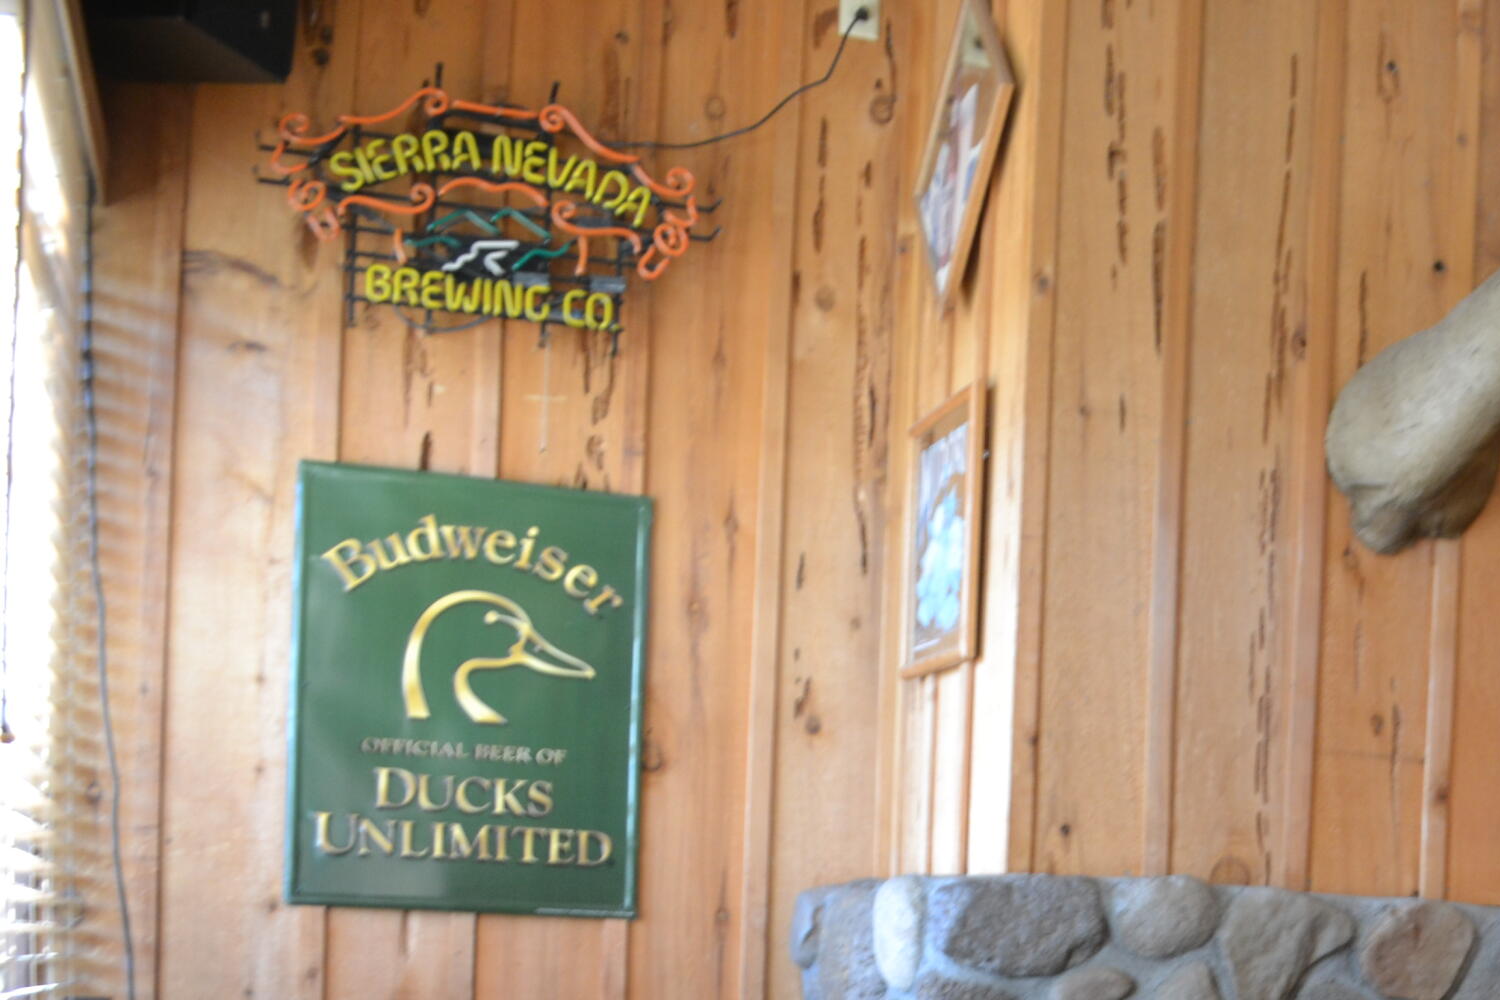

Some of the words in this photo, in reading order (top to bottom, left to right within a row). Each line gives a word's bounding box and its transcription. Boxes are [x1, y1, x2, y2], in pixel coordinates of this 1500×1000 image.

[329, 129, 482, 193] SIERRA
[490, 133, 652, 228] NEVADA
[364, 262, 551, 323] BREWING
[321, 513, 625, 616] Budweiser
[361, 736, 469, 759] OFFICIAL
[475, 743, 532, 764] BEER
[535, 747, 568, 765] OF
[373, 766, 553, 818] DUCKS
[314, 811, 613, 867] UNLIMITED
